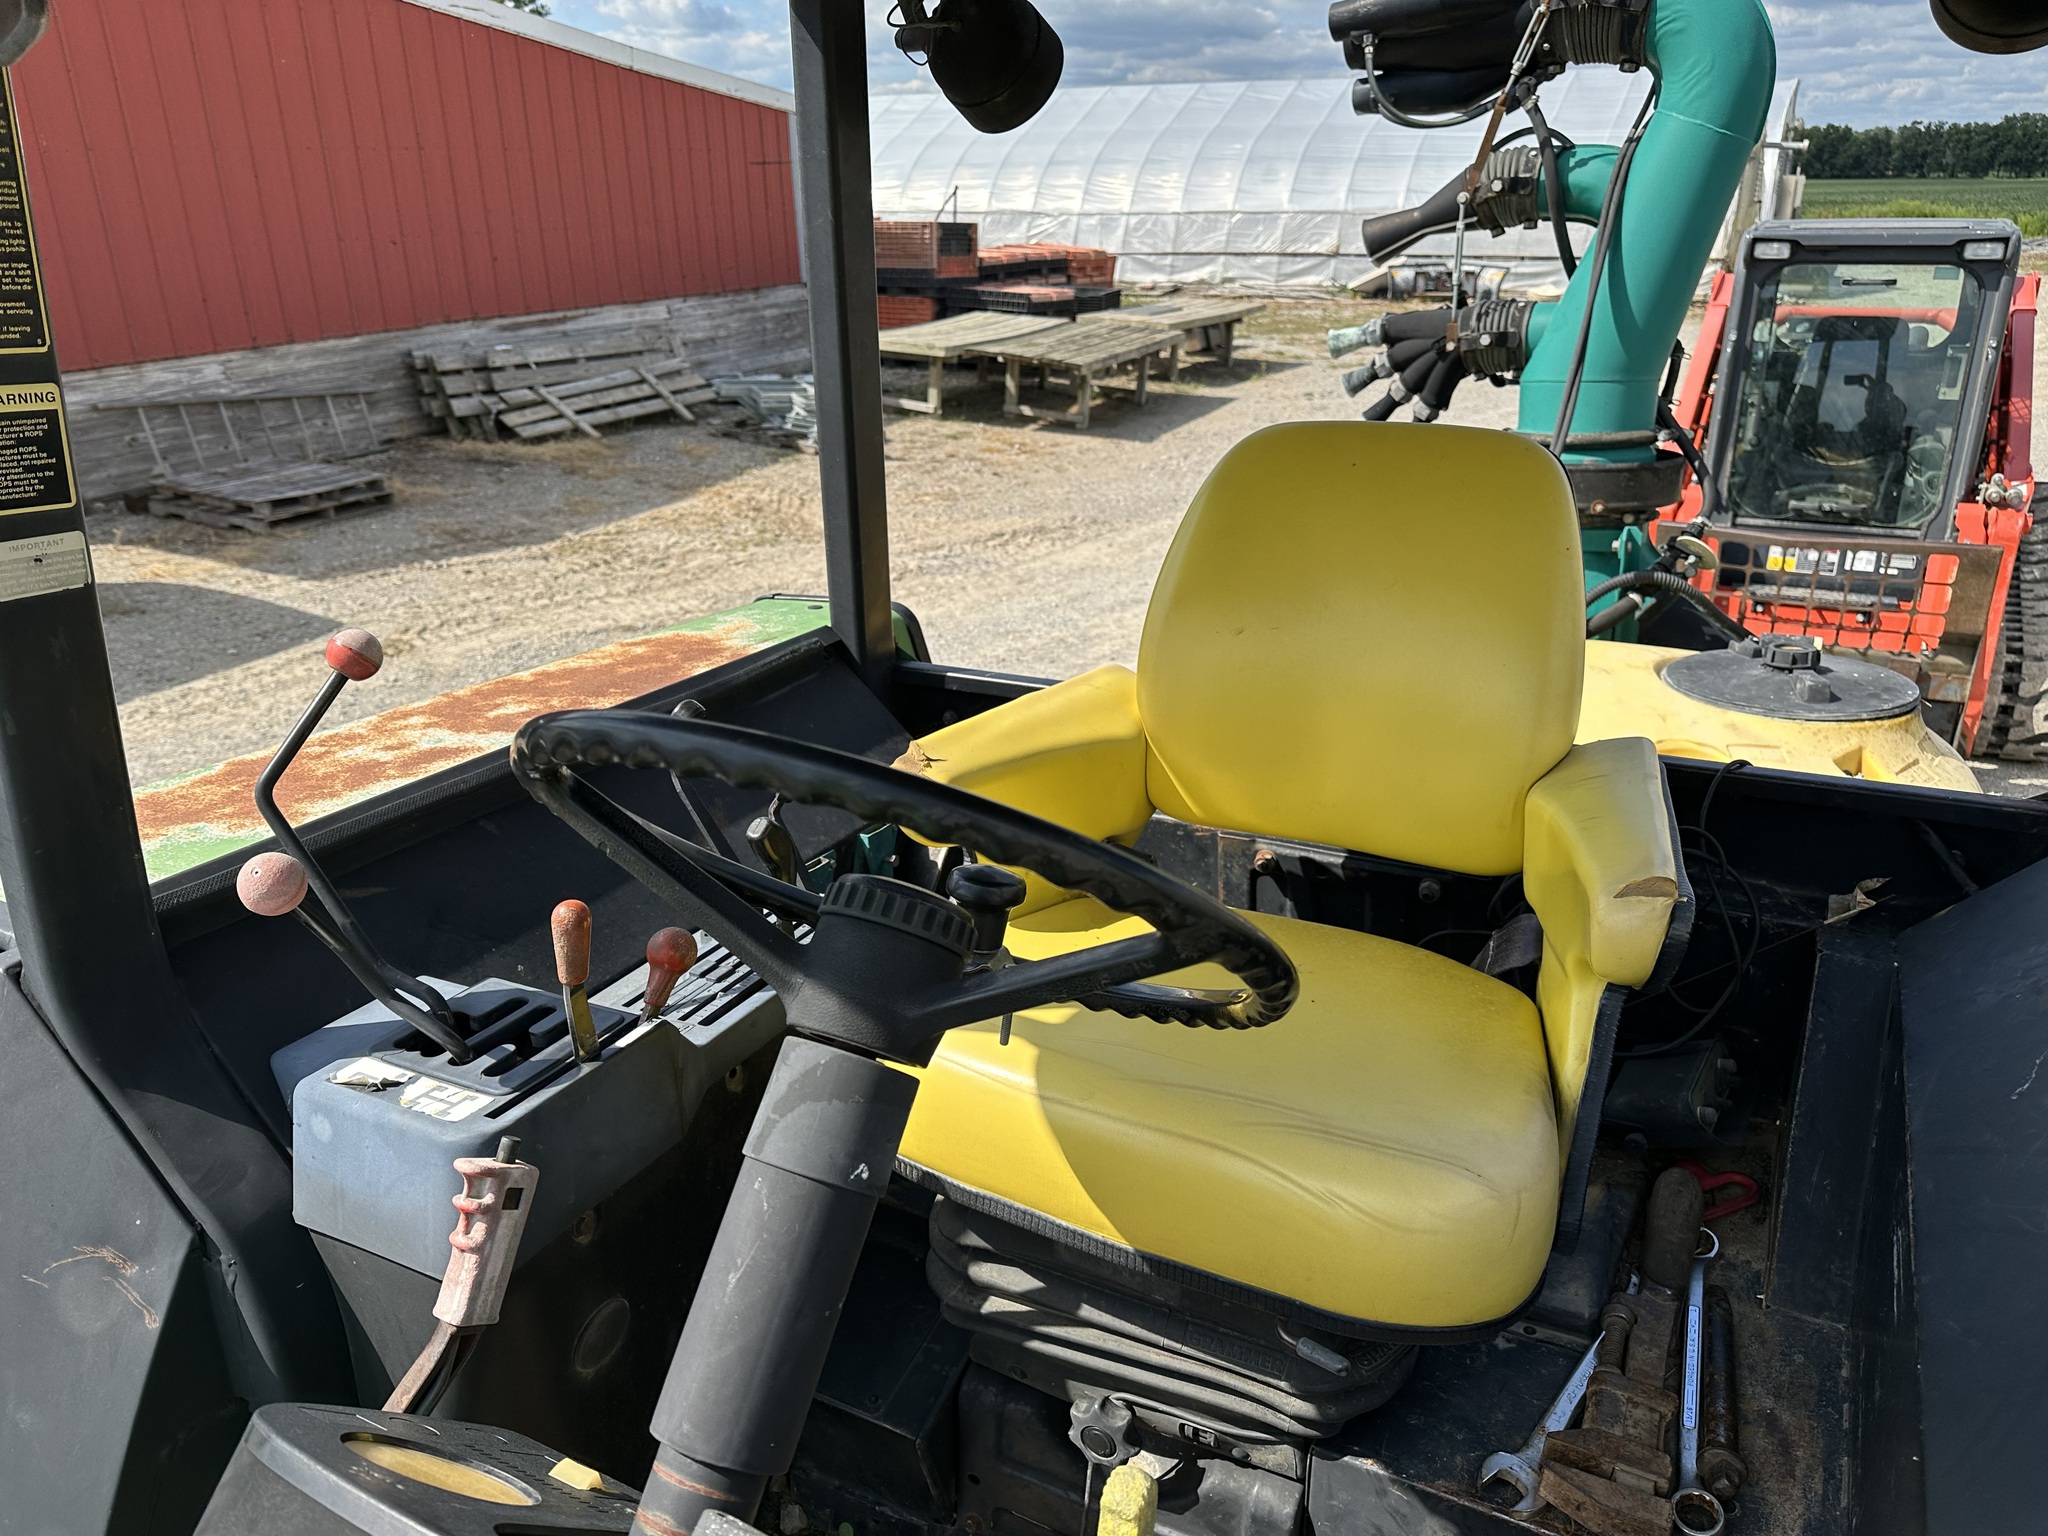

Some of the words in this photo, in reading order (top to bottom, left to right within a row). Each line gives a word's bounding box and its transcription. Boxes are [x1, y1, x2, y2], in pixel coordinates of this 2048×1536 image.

[12, 417, 47, 426] unimpaired
[3, 425, 35, 433] protection
[31, 458, 56, 467] repaired
[6, 473, 36, 481] alteration
[8, 538, 65, 553] IMPORTANT
[1189, 1333, 1285, 1373] GRAMMER
[1687, 1363, 1695, 1387] FORGED
